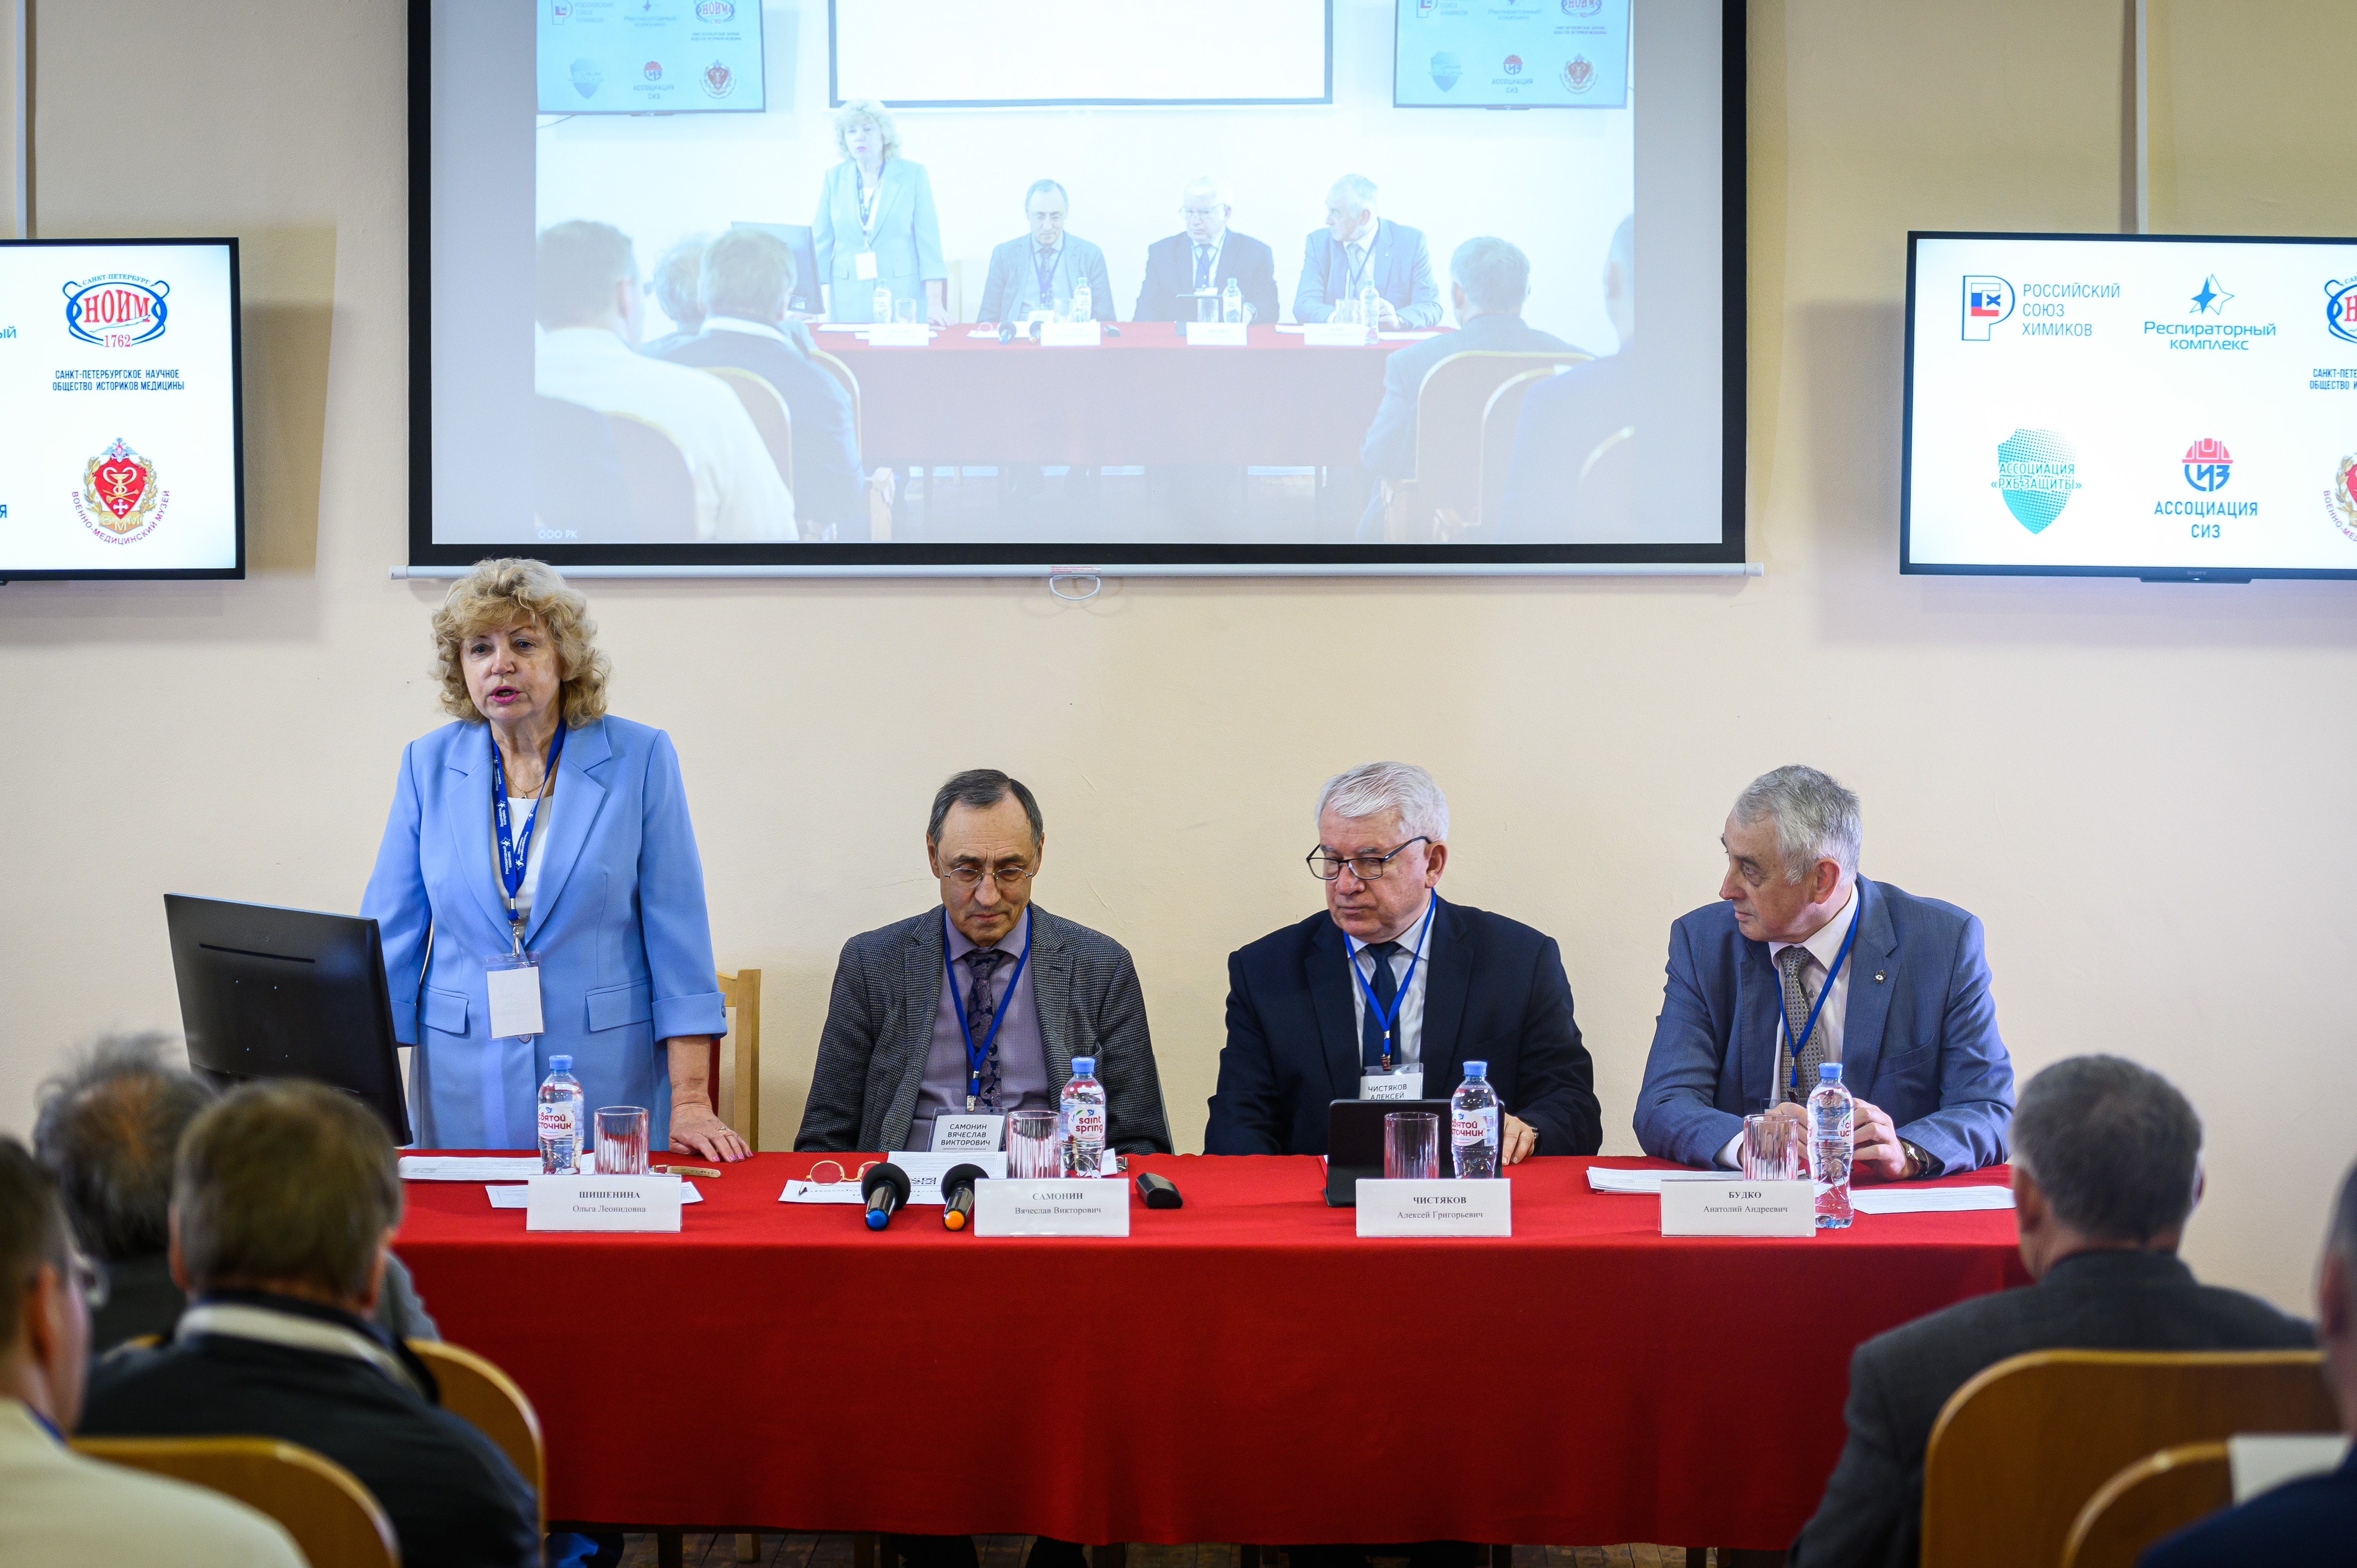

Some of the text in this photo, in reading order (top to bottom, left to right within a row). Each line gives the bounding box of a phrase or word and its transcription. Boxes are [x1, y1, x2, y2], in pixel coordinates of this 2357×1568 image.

[82, 274, 150, 285] САНКТ-ПЕТЕРБУРГ
[2023, 282, 2120, 297] РОССИЙСКИЙ
[83, 289, 150, 323] НОИМ
[2023, 303, 2065, 317] СОЮЗ
[2022, 323, 2092, 336] ХИМИКОВ
[2144, 321, 2276, 338] Респираторный
[104, 334, 131, 347] 1762
[2170, 339, 2249, 350] комплекс
[56, 369, 179, 379] САНКТ-ПЕТЕРБУРГСКОЕ НАУЧНОЕ
[52, 381, 184, 391] ОБЩЕСТВО ИСТОРИКОВ МЕДИЦИНЫ
[2310, 381, 2350, 390] ОБЩЕСТВО
[1999, 463, 2074, 476] АССОЦИАЦИЯ
[2154, 501, 2258, 518] АССОЦИАЦИЯ
[72, 490, 170, 545] ВОЕННО-МЕДИЦИНСКИЙ МУЗЕЙ
[2191, 524, 2221, 538] СИЗ
[1368, 1083, 1407, 1092] ЧИСТЯКОВ
[1370, 1091, 1405, 1100] АЛЕКСЕЙ
[1078, 1116, 1101, 1124] saint
[1075, 1124, 1103, 1135] spring
[572, 1205, 646, 1214] Ольга Леонидовна
[1015, 1207, 1102, 1216] Вячеслав Викторович
[1397, 1210, 1483, 1220] Алексей Григорьевич
[1703, 1205, 1788, 1214] Анатолий Андреевич
